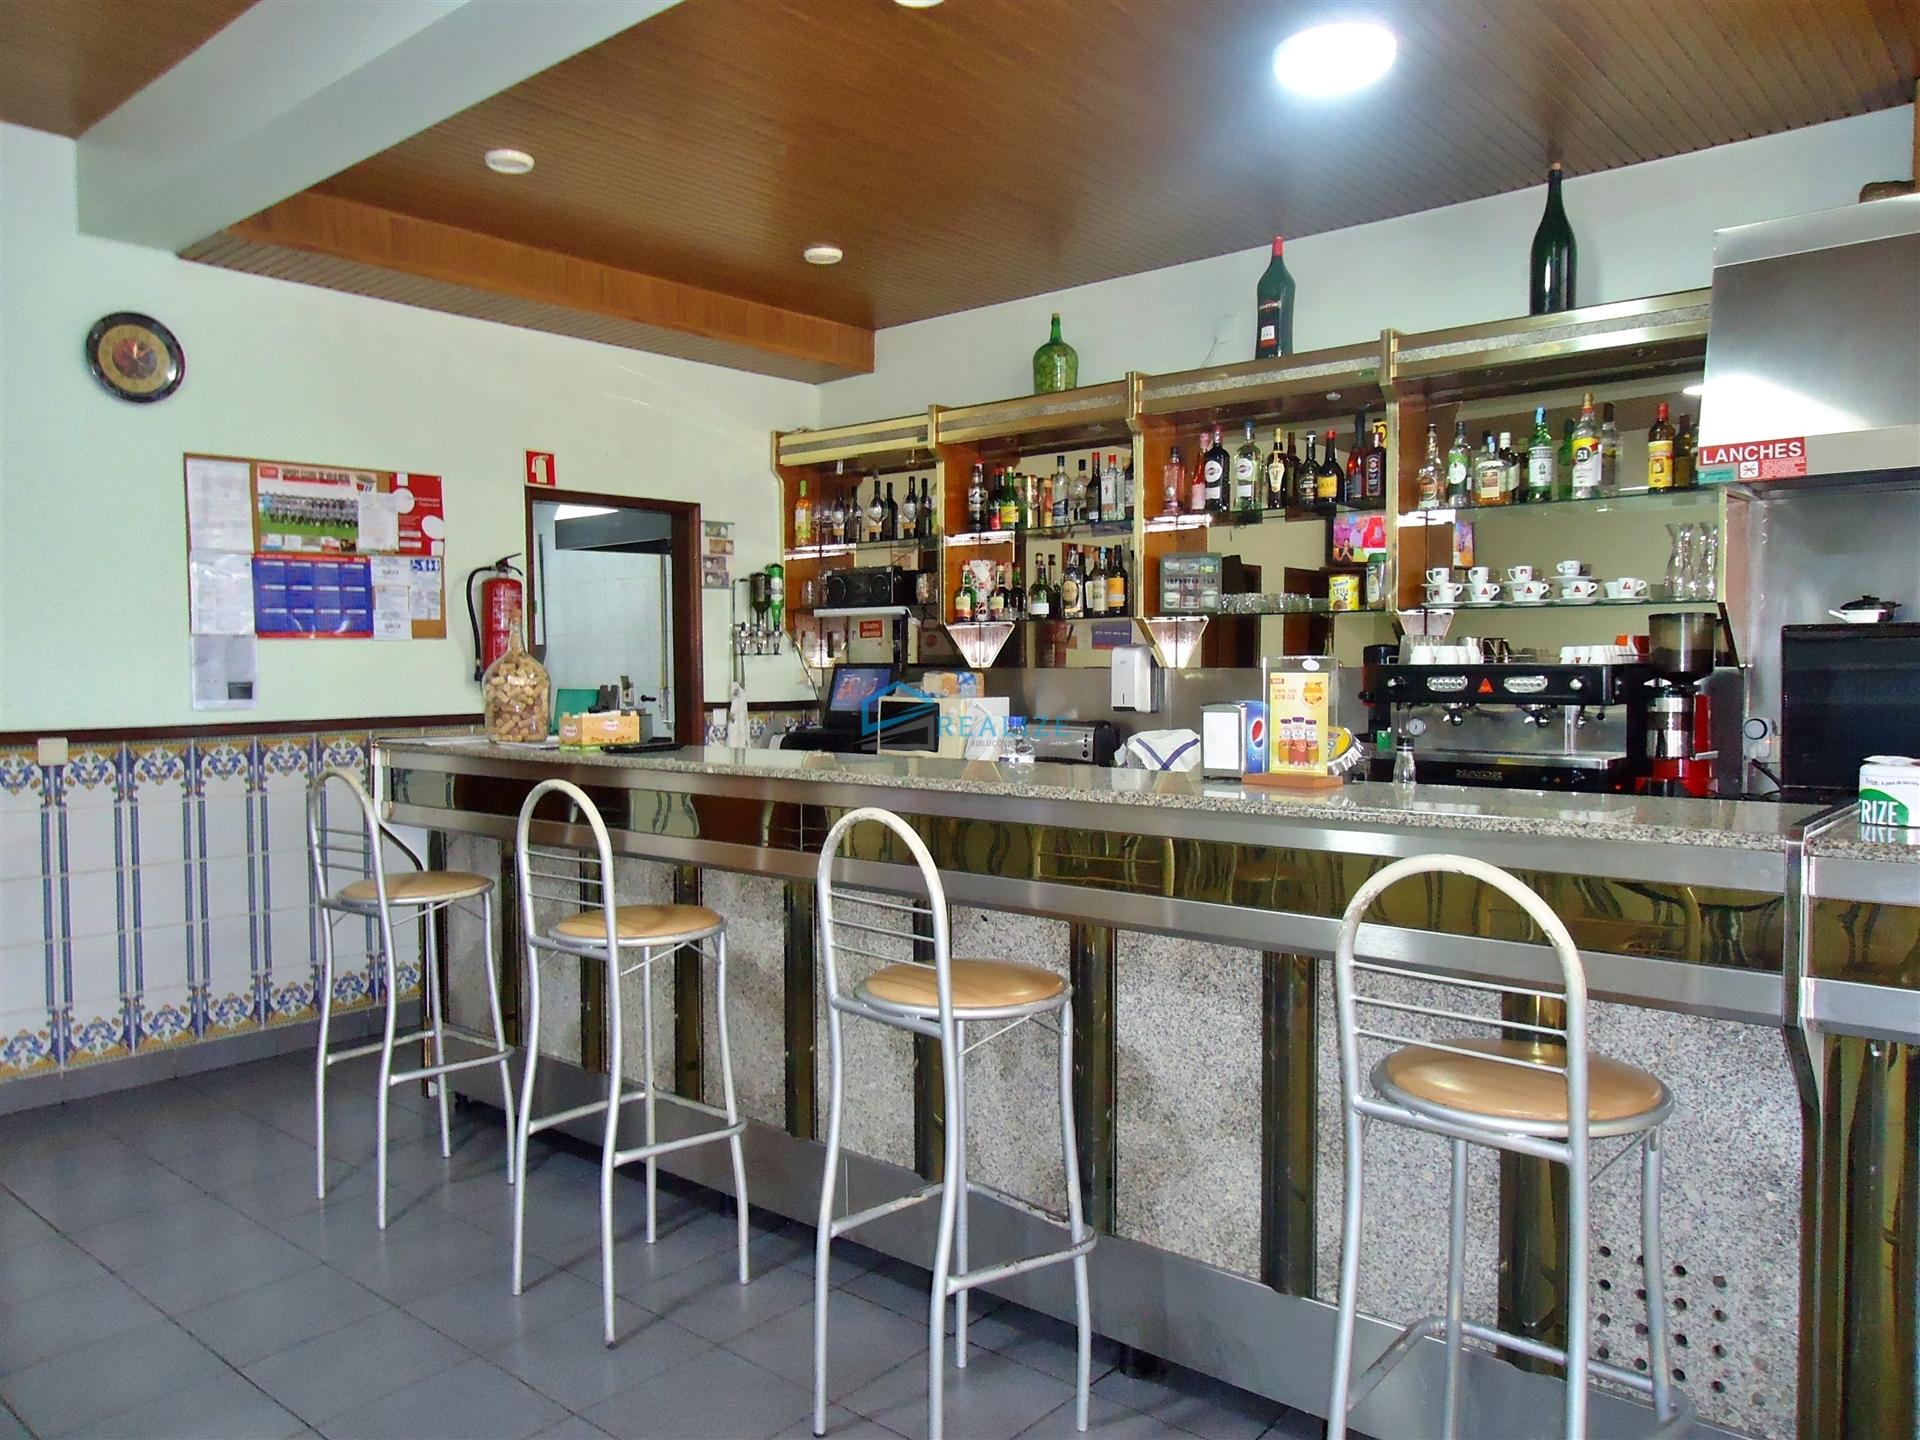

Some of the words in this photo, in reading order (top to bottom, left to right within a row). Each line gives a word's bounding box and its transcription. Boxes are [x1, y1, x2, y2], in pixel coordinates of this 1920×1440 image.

[1577, 450, 1588, 460] 51
[1702, 441, 1802, 464] LANCHES
[1859, 800, 1899, 826] RIZE
